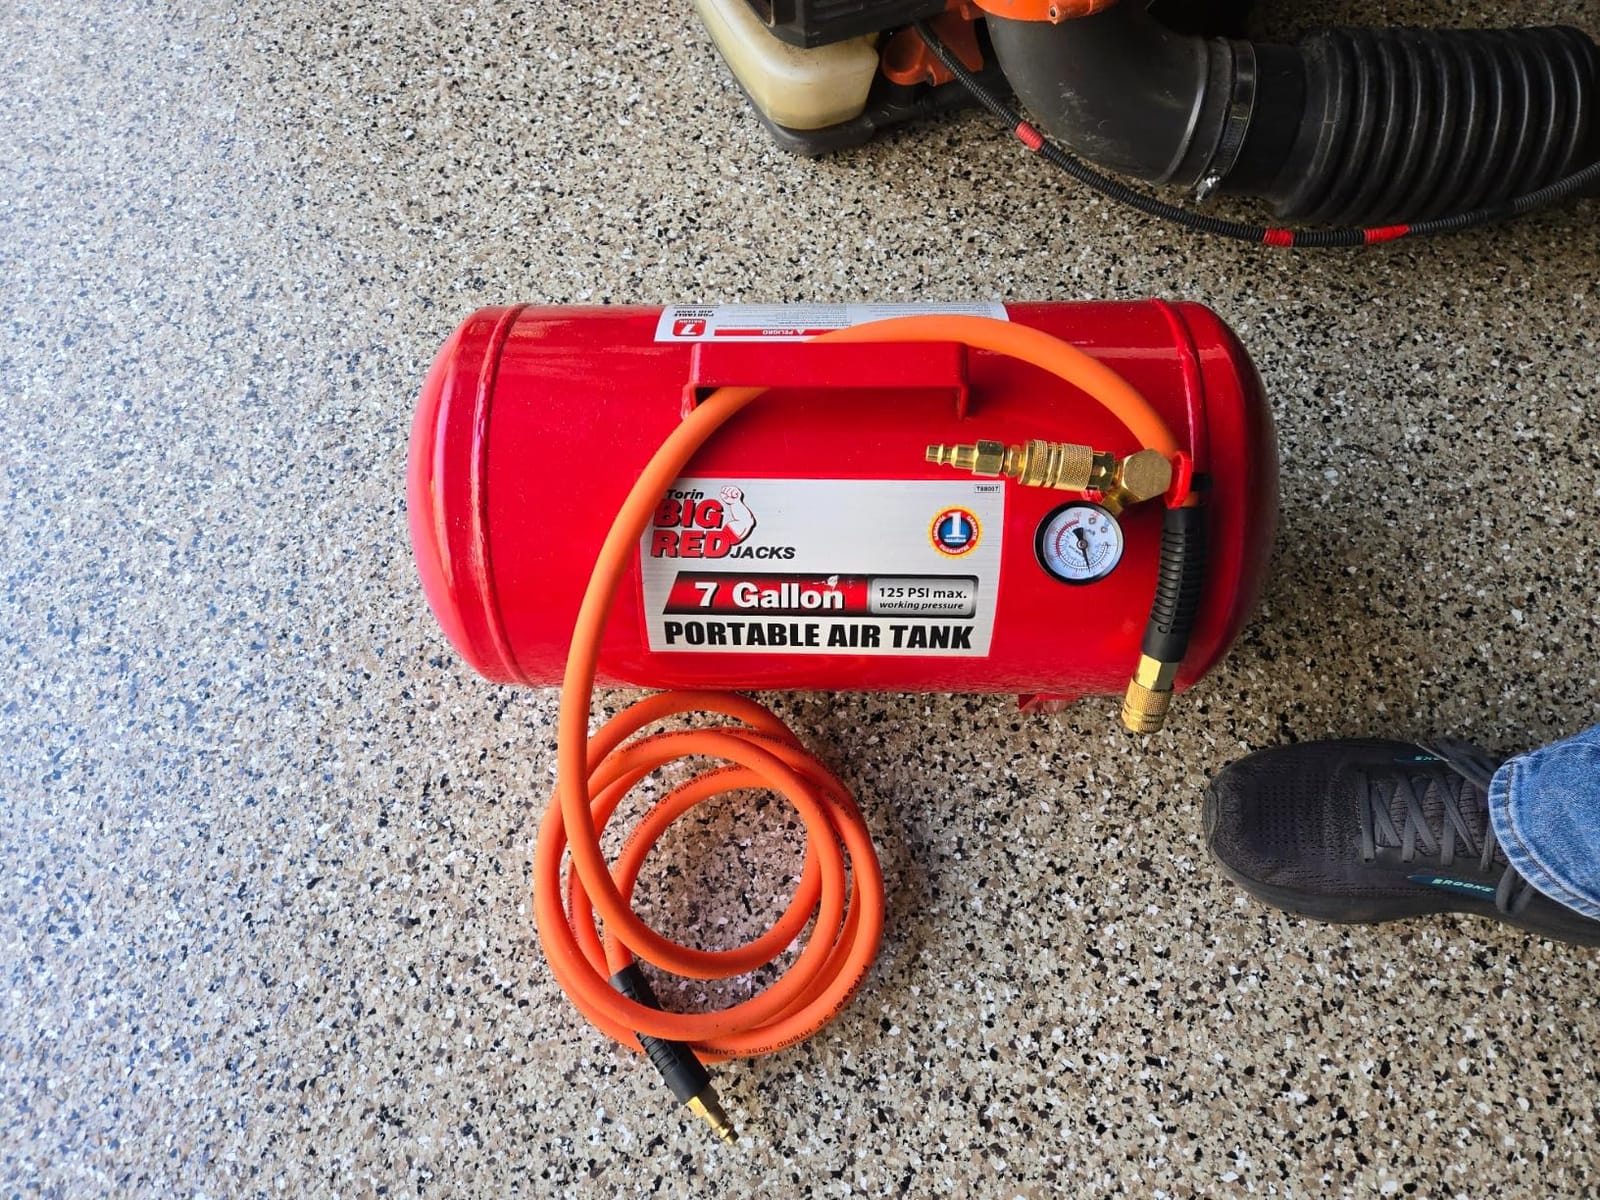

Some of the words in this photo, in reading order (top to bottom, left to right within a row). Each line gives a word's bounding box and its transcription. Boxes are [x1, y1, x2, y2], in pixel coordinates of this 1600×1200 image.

[680, 324, 698, 336] 7
[667, 489, 704, 500] Torin
[653, 499, 725, 529] BIG
[944, 511, 967, 543] 1
[650, 530, 732, 559] RED
[730, 546, 796, 560] JACKS
[695, 582, 719, 607] 7
[732, 582, 845, 609] Gallon
[879, 587, 904, 598] 125
[908, 588, 930, 599] PSI
[933, 590, 968, 599] max.
[879, 601, 920, 610] working
[664, 621, 820, 647] PORTABLE
[827, 624, 881, 648] AIR
[890, 625, 975, 649] TANK
[1431, 878, 1496, 893] BROOKS
[777, 1027, 814, 1048] HYBRID
[747, 1045, 774, 1055] HOSE
